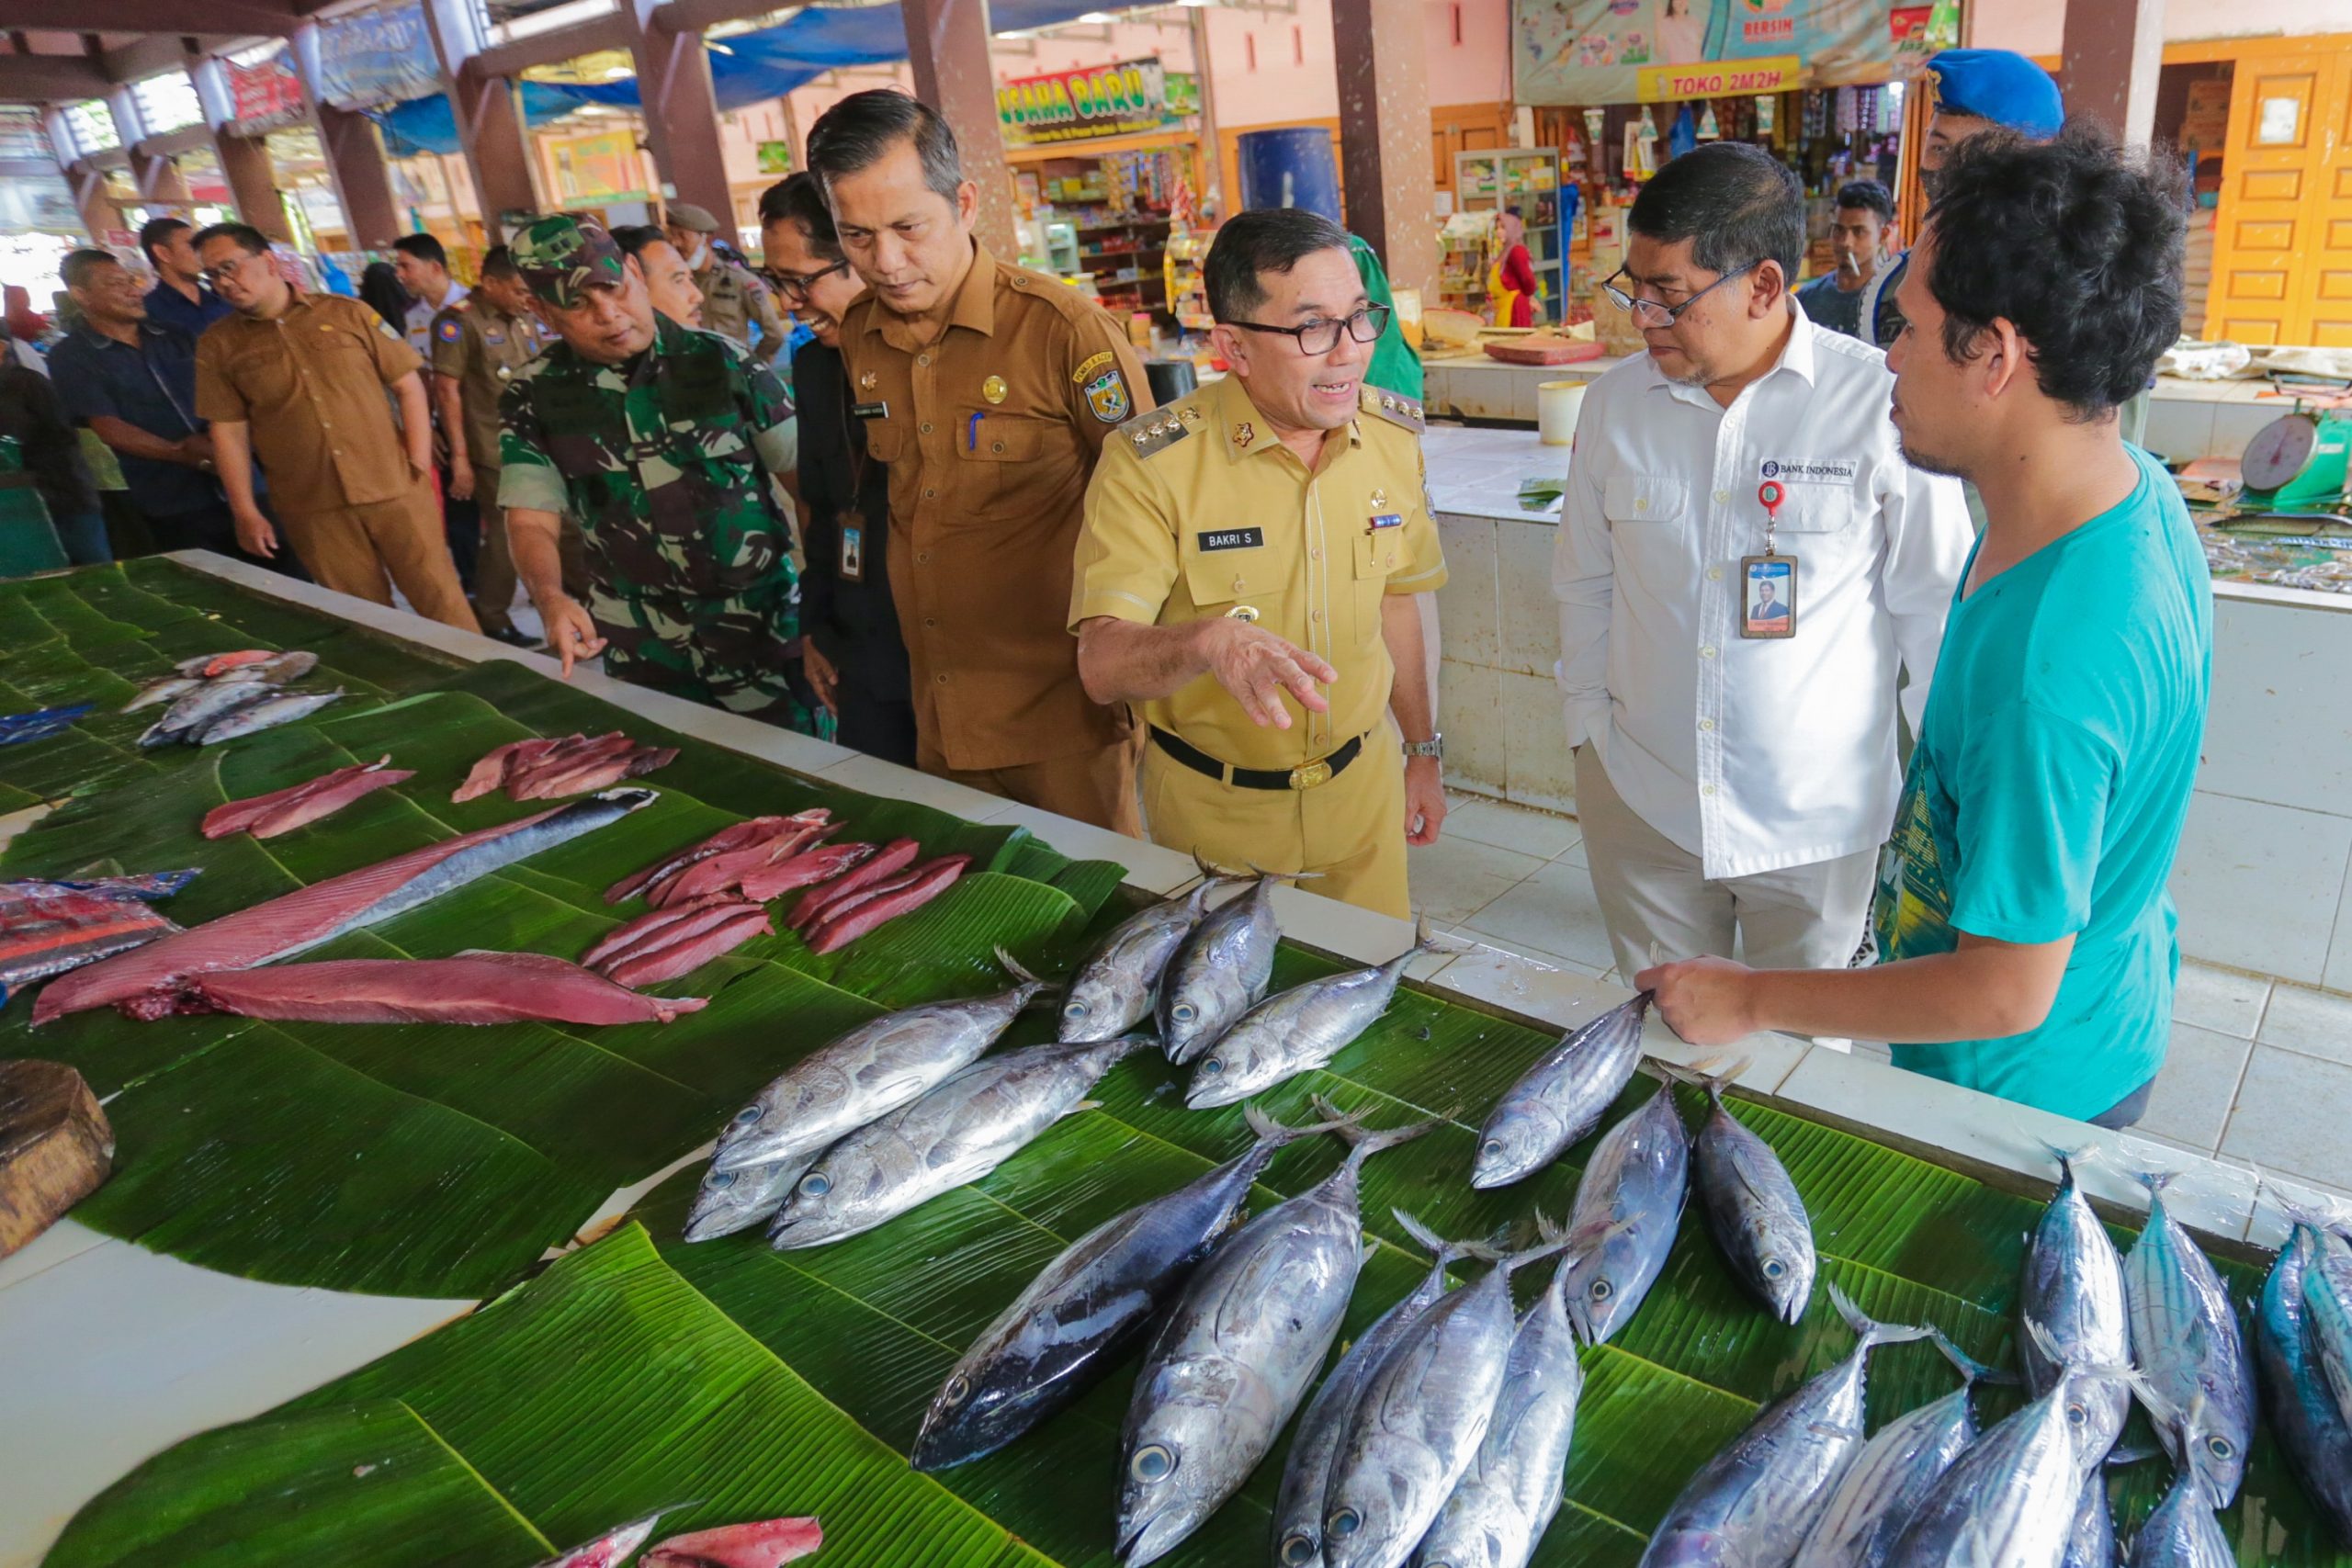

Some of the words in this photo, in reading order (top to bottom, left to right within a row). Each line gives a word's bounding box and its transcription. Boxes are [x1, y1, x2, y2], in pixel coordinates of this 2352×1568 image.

[1068, 65, 1147, 118] BARU
[1673, 75, 1723, 95] TOKO
[1729, 72, 1781, 91] 2M2H
[1781, 465, 1804, 474] BANK
[1806, 467, 1853, 478] INDONESIA
[1208, 534, 1240, 547] BAKRI
[1244, 533, 1252, 544] S
